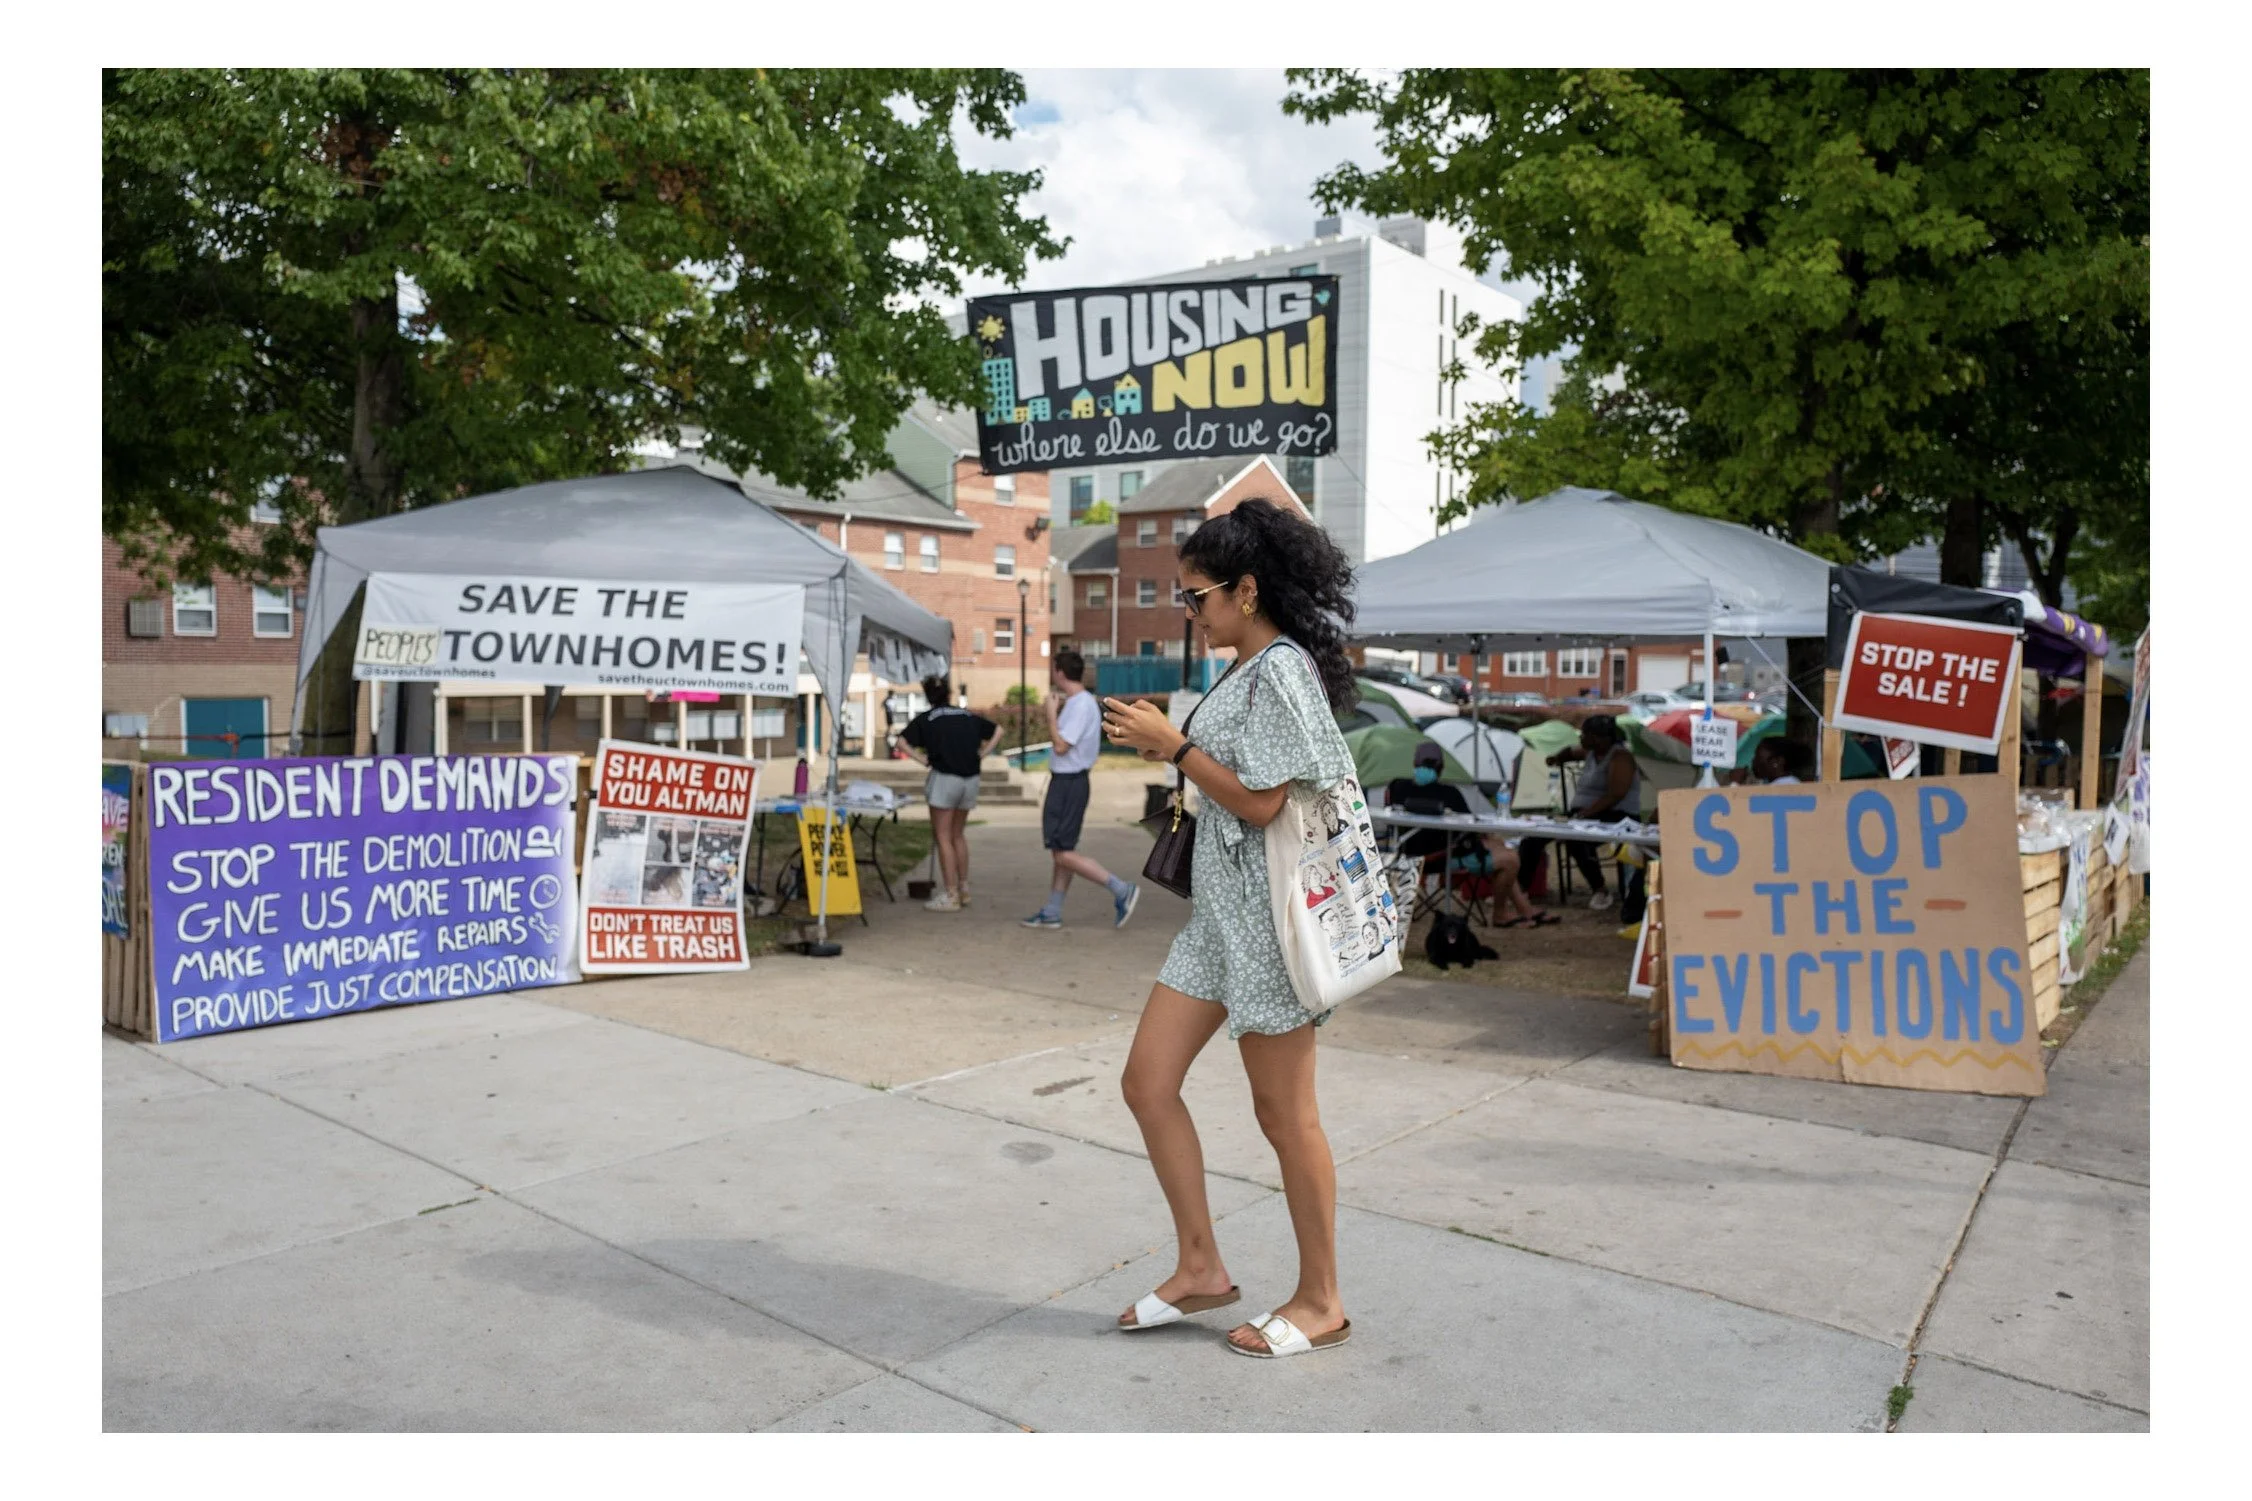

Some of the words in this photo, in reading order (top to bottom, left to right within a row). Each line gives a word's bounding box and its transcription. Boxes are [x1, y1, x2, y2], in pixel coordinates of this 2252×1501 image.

[1010, 282, 1314, 400] HOUSING
[1152, 314, 1327, 413] NOW
[991, 422, 1087, 467] where
[1095, 416, 1162, 456] else
[1173, 411, 1221, 450] do
[1226, 418, 1271, 448] we
[1277, 412, 1332, 455] go?
[458, 584, 578, 616] SAVE
[597, 588, 688, 619] THE
[444, 629, 786, 675] TOWNHOMES!
[1860, 642, 1935, 673] STOP
[1941, 653, 2000, 684] THE
[597, 672, 789, 692] savetheuctownhomes.com
[1877, 671, 1953, 705] SALE
[153, 758, 375, 828] RESIDENT
[379, 756, 570, 813] DEMANDS
[605, 779, 652, 806] YOU
[654, 785, 746, 816] ALTMAN
[607, 753, 706, 787] SHAME
[713, 766, 750, 793] ON
[1692, 785, 1968, 877] STOP
[166, 843, 276, 894] STOP
[289, 840, 350, 880] THE
[363, 827, 521, 874] DEMOLITION
[177, 893, 281, 943] GIVE
[301, 886, 352, 930] US
[365, 877, 449, 924] MORE
[461, 876, 526, 913] TIME
[589, 912, 646, 933] DON'T
[649, 914, 706, 934] TREAT
[709, 916, 734, 935] US
[1753, 878, 1916, 936] THE
[172, 945, 265, 985] MAKE
[283, 929, 420, 977] IMMEDIATE
[437, 915, 528, 953] REPAIRS
[590, 934, 648, 959] LIKE
[653, 935, 736, 960] TRASH
[171, 985, 295, 1034] PROVIDE
[304, 973, 374, 1014] JUST
[379, 954, 557, 1002] COMPENSATION
[1673, 947, 2025, 1044] EVICTIONS
